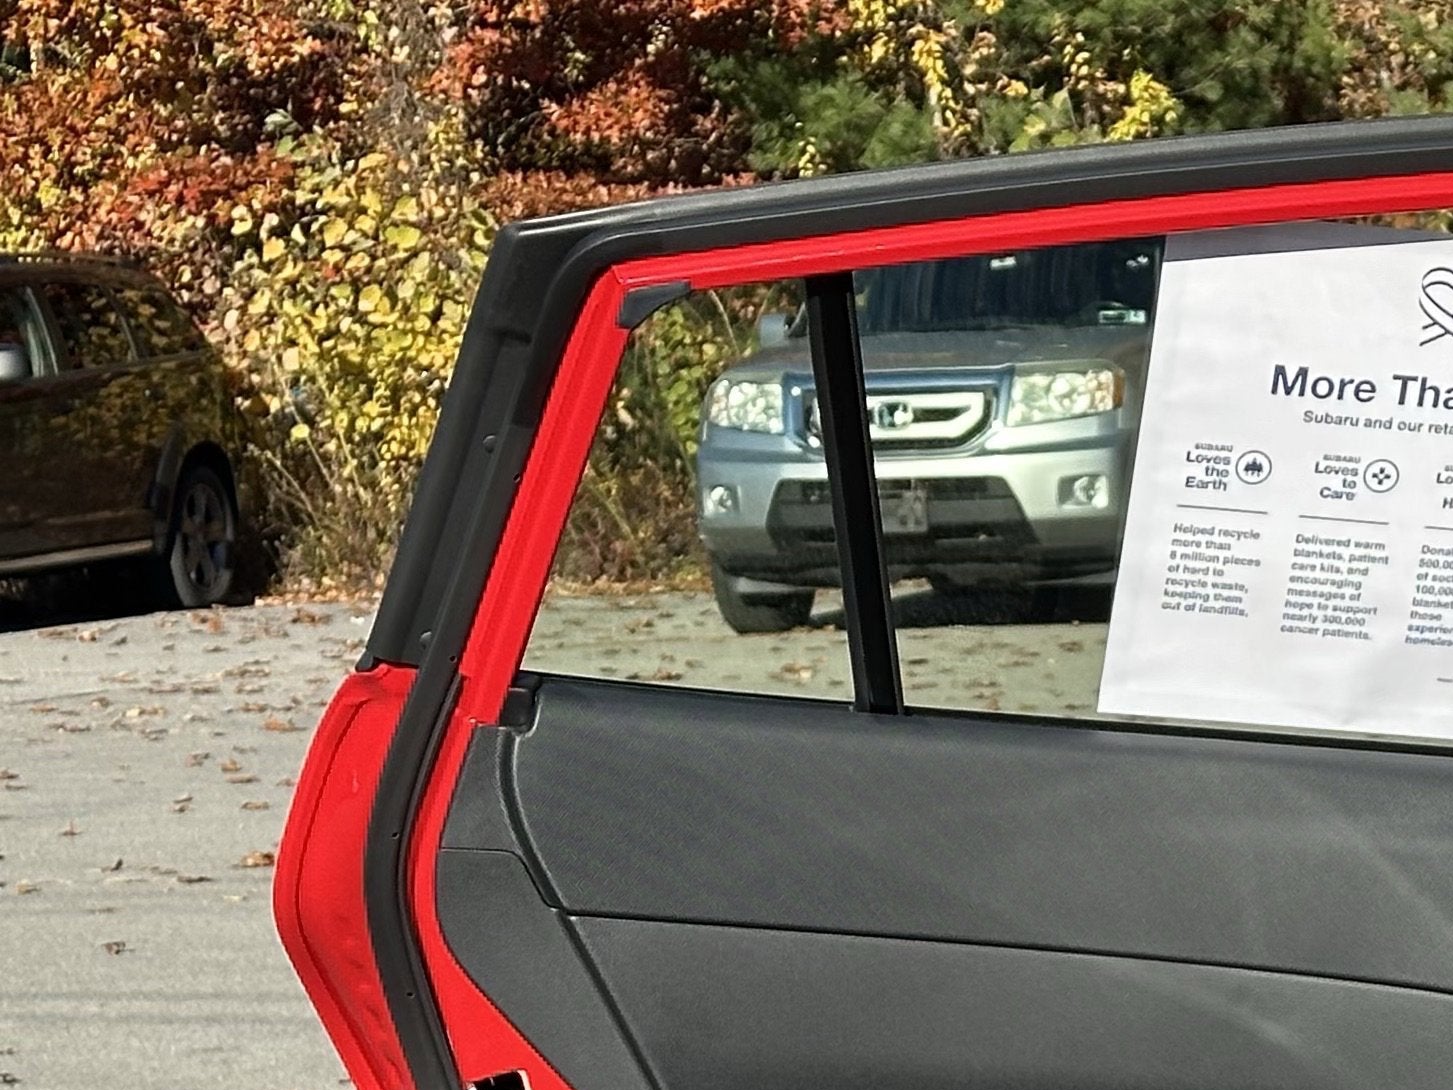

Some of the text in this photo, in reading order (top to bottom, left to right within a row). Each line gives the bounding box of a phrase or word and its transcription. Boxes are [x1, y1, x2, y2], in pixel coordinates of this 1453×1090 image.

[1271, 365, 1376, 403] More
[1303, 410, 1359, 427] Subaru
[1363, 417, 1393, 430] and
[1397, 421, 1424, 433] our
[1186, 450, 1231, 465] Loves
[1205, 464, 1229, 478] the
[1314, 462, 1358, 477] Loves
[1185, 475, 1227, 491] Earth
[1342, 477, 1357, 489] to
[1319, 487, 1356, 501] Care
[1173, 522, 1260, 540] Helped recycle
[1171, 538, 1231, 551] more than
[1296, 534, 1385, 551] Delivered warm
[1180, 551, 1220, 564] million
[1222, 554, 1261, 567] pieces
[1348, 553, 1389, 565] patient
[1167, 563, 1224, 577] of hard to
[1291, 561, 1317, 572] care
[1347, 566, 1369, 576] and
[1165, 577, 1208, 589] recycle
[1289, 574, 1362, 591] encouraging
[1416, 571, 1429, 581] of
[1349, 591, 1361, 602] of
[1184, 601, 1196, 611] of
[1284, 598, 1378, 615] hope to support
[1282, 612, 1318, 624] nearly
[1410, 609, 1442, 621] those
[1280, 624, 1320, 635] cancer
